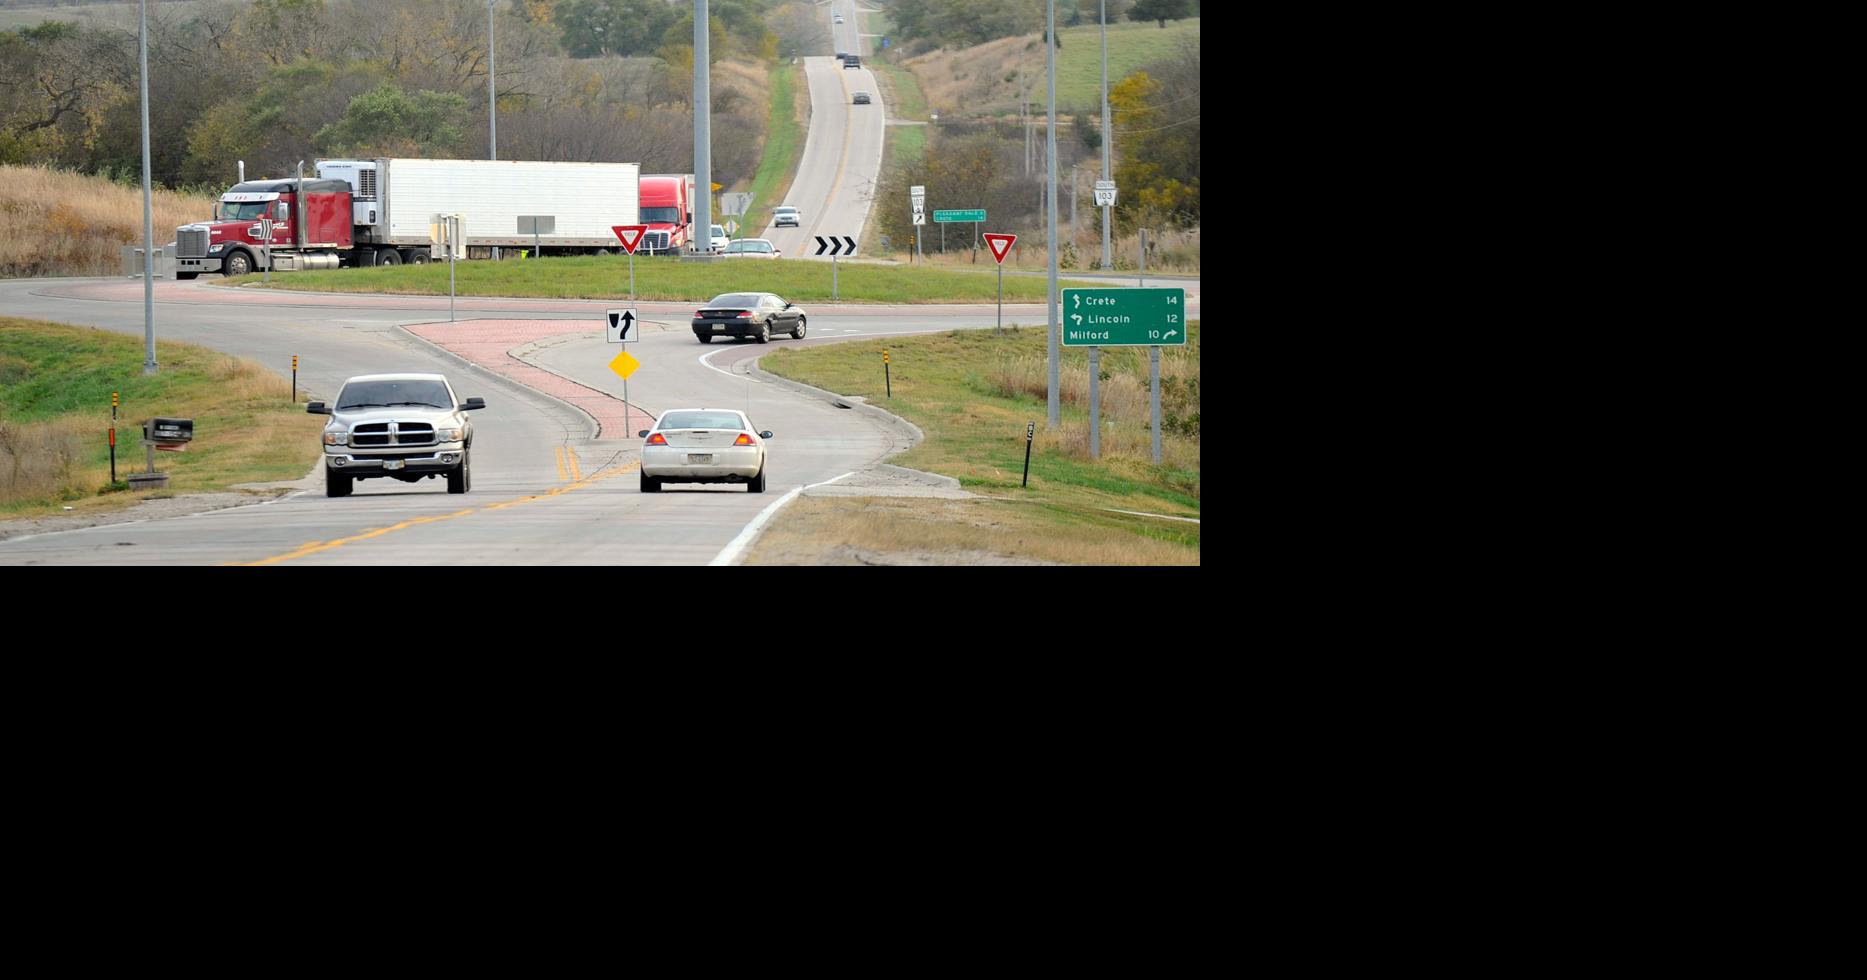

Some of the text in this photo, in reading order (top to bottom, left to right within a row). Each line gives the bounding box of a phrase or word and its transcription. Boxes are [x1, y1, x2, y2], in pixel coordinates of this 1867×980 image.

[1098, 192, 1112, 200] 103
[913, 198, 922, 206] 103
[1085, 296, 1177, 306] Crete 14
[1088, 314, 1178, 324] Lincoln 12
[1069, 330, 1160, 340] Milford 10
